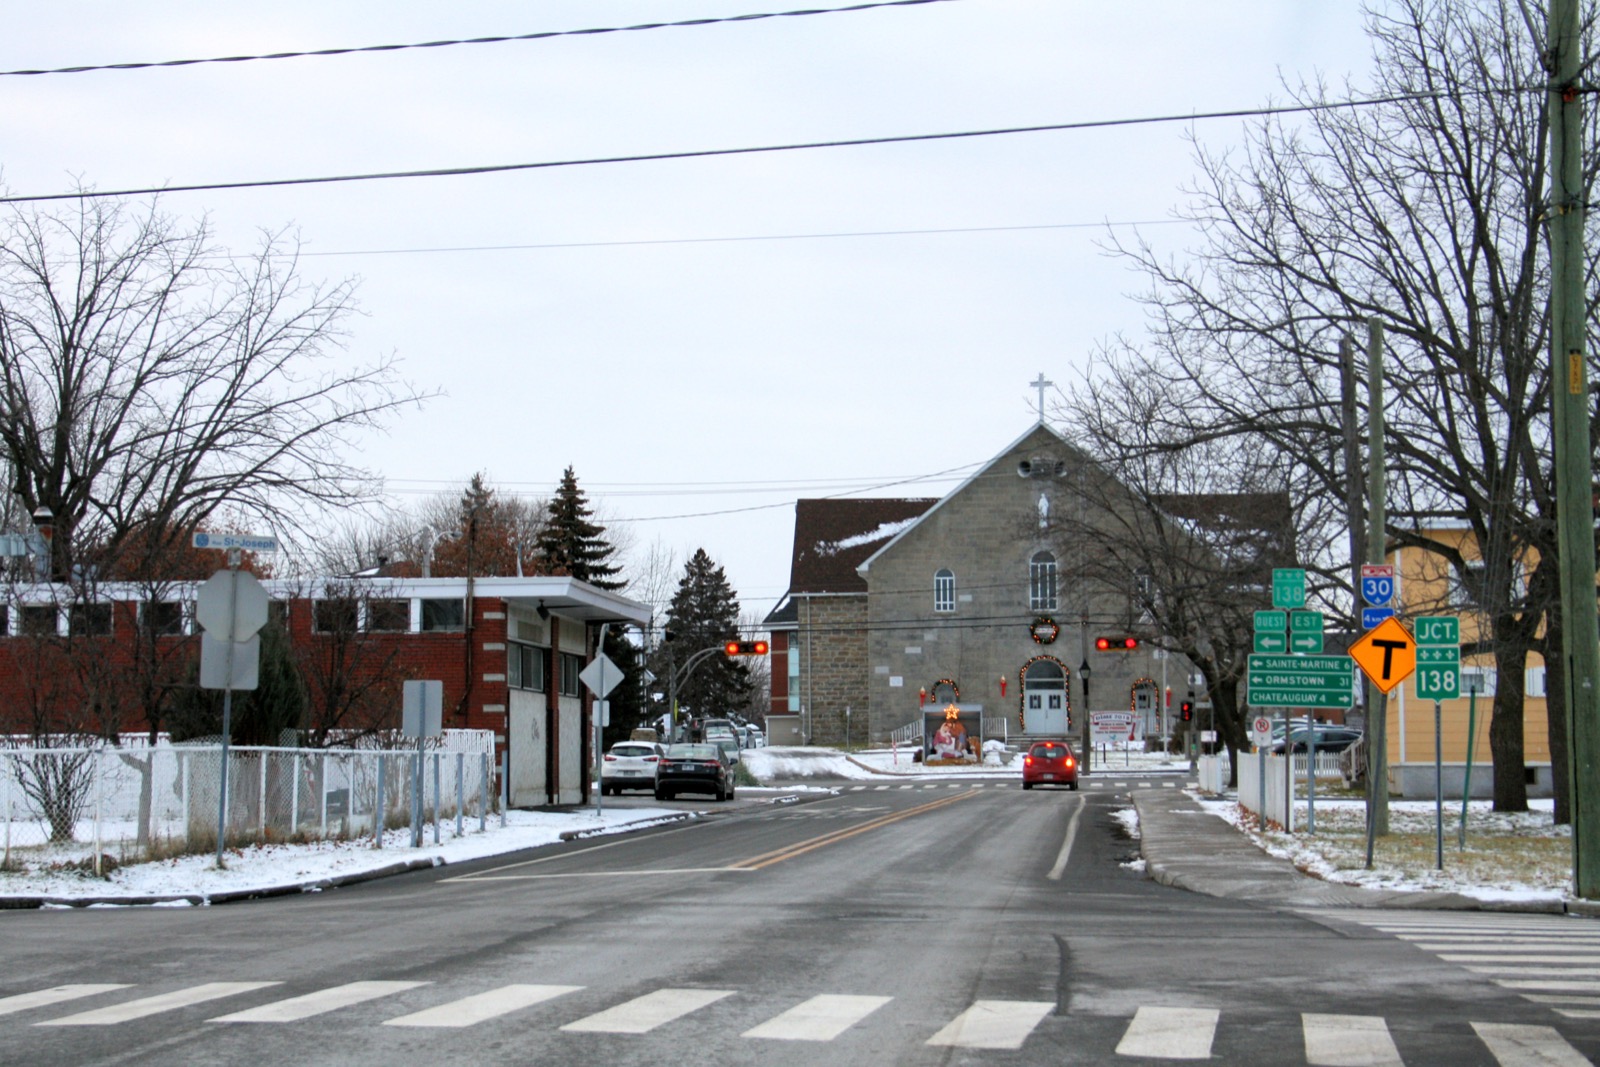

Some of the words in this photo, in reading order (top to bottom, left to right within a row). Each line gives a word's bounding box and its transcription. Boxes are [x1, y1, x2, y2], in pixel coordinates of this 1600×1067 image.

[224, 537, 275, 549] St-Joseph
[1366, 579, 1390, 596] 30
[1275, 586, 1303, 602] 138
[1256, 616, 1284, 627] OUEST
[1295, 616, 1318, 627] EST
[1364, 614, 1371, 622] 4
[1419, 622, 1456, 640] JCT.
[1265, 659, 1340, 670] SAINTE-MARTINE
[1343, 661, 1351, 670] 6
[1265, 675, 1325, 686] ORMSTOWN
[1339, 677, 1350, 687] 31
[1420, 670, 1456, 692] 138
[1252, 692, 1317, 703] CHATEAUGUAY
[1319, 694, 1326, 703] 4
